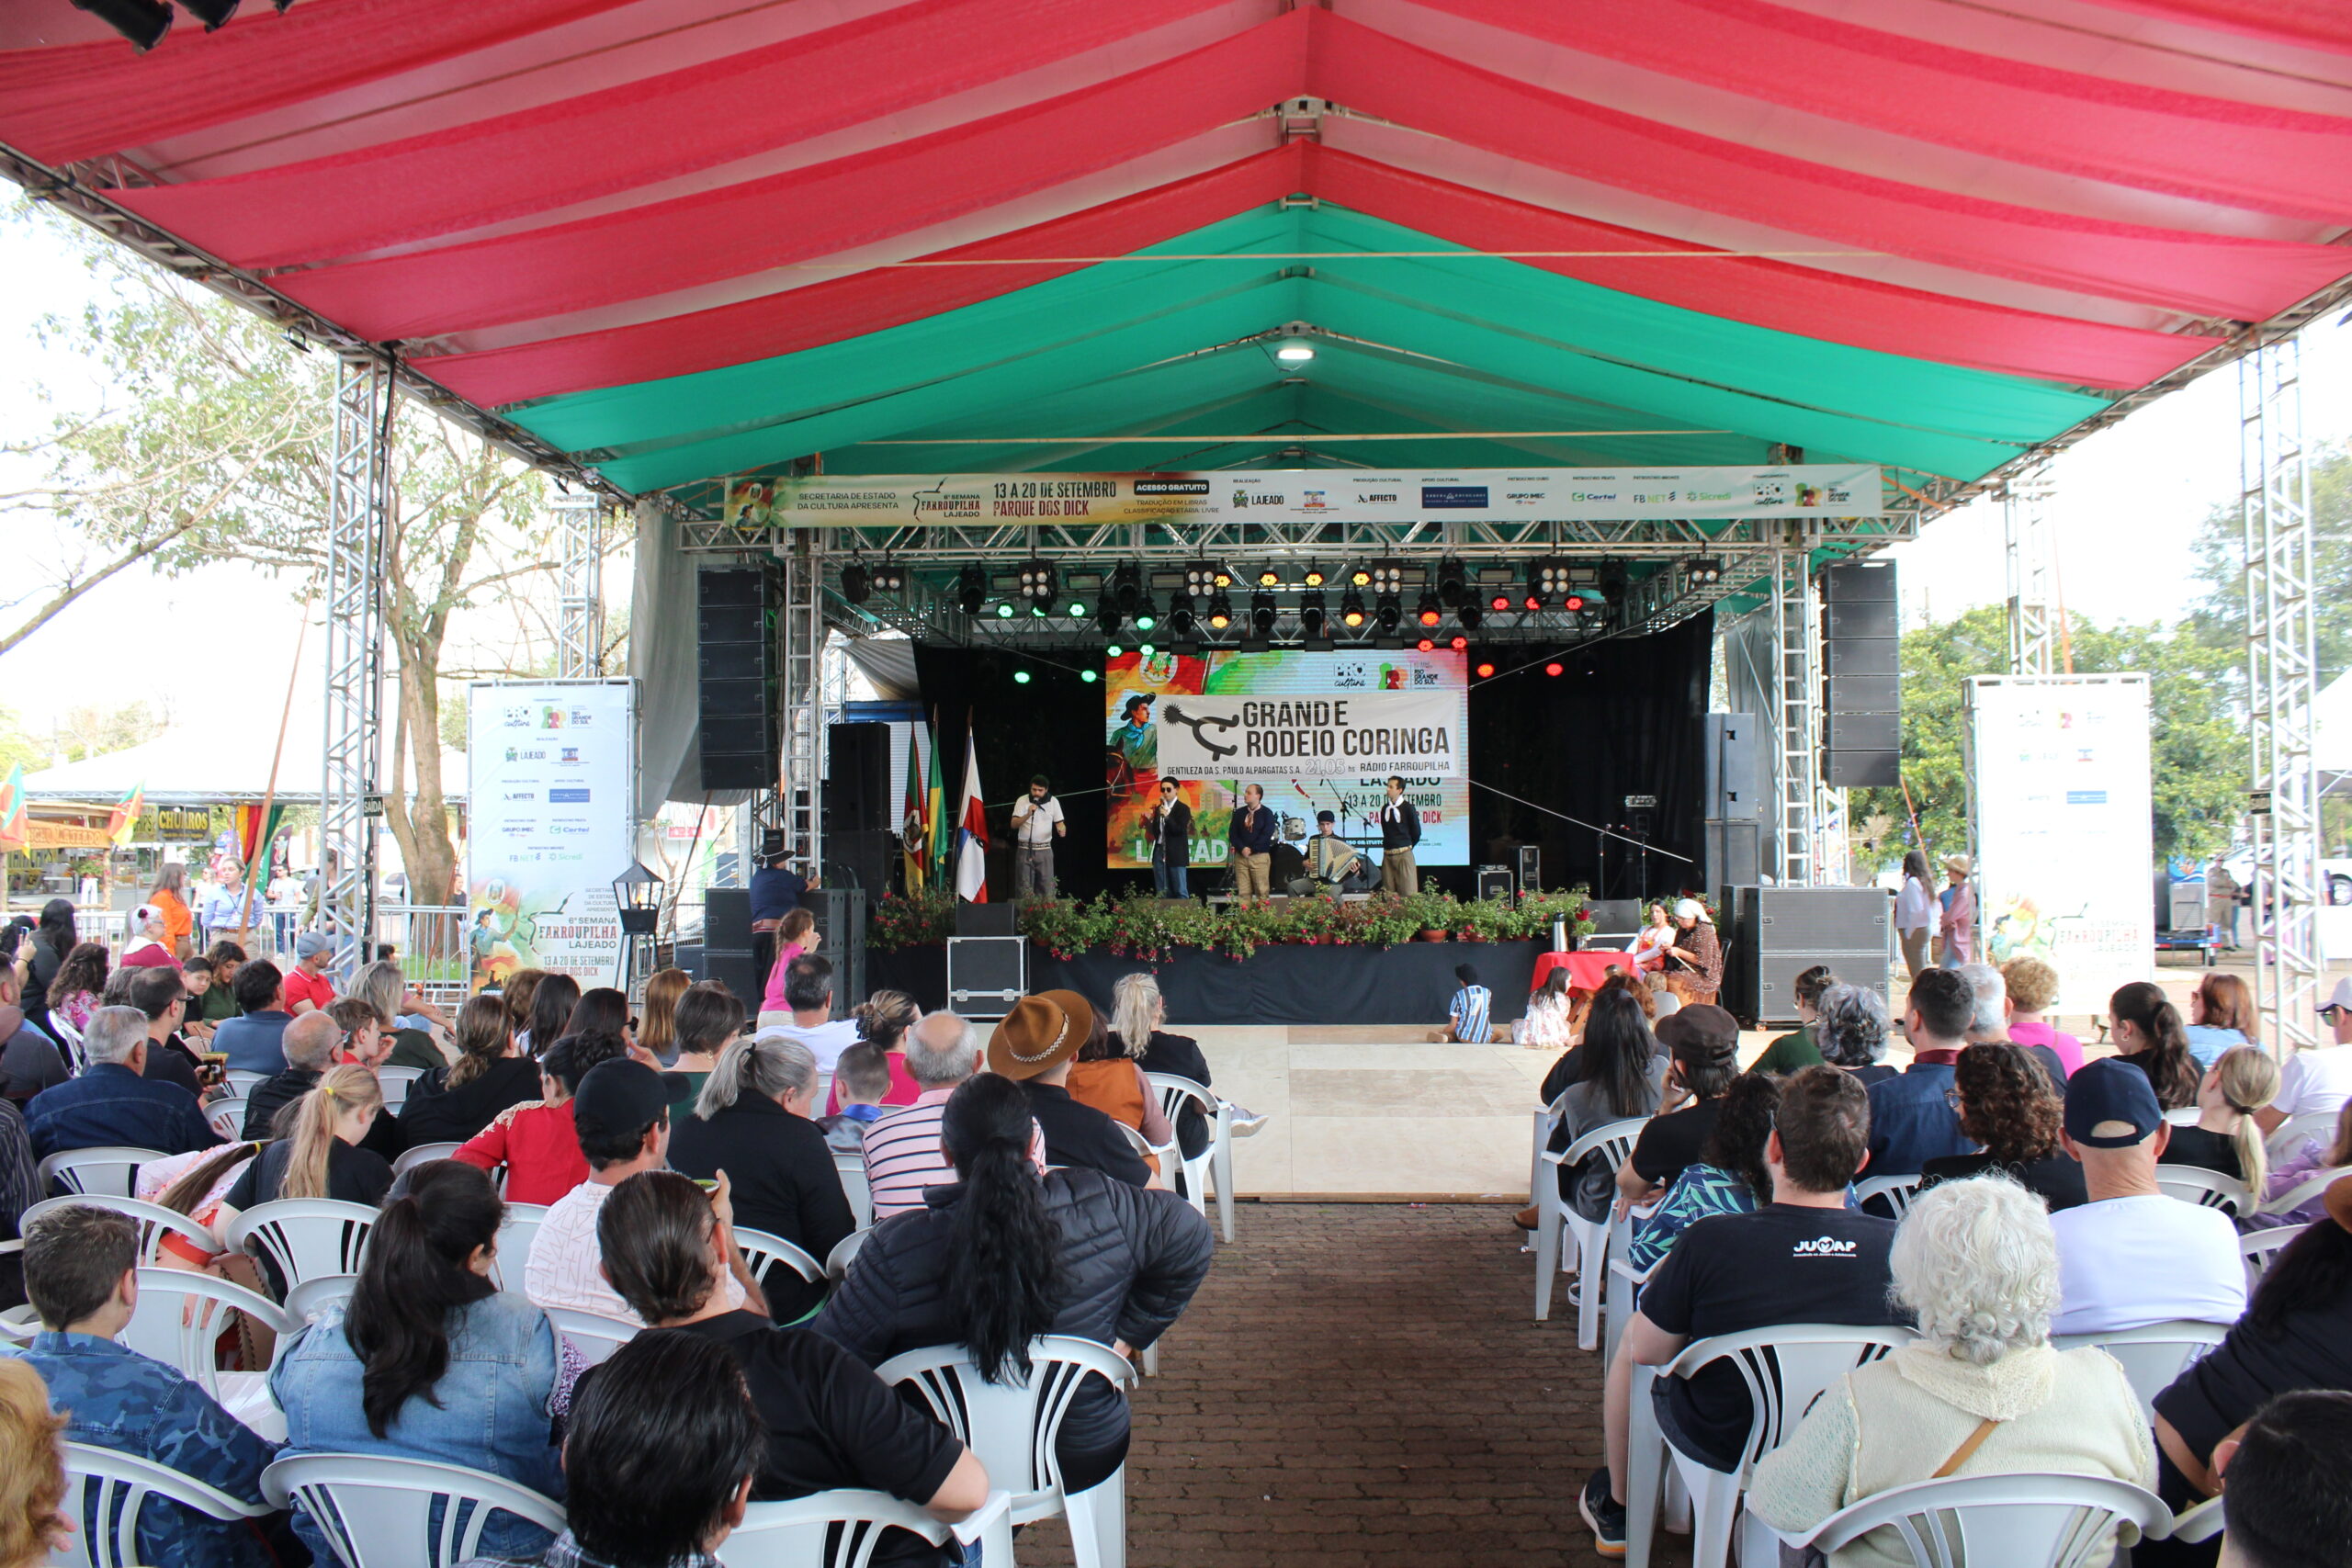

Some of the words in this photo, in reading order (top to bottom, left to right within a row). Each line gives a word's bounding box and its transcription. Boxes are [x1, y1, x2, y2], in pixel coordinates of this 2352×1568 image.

[993, 483, 1007, 499] 13
[1011, 482, 1017, 498] A
[1022, 482, 1036, 498] 20
[1040, 482, 1054, 497] DE
[1057, 481, 1116, 497] SETEMBRO
[1136, 483, 1168, 491] ACESSO
[1168, 483, 1207, 491] GRATUITO
[798, 492, 849, 501] SECRETARIA
[863, 491, 897, 500] ESTADO
[1251, 494, 1284, 505] LAJEADO
[1700, 491, 1731, 501] Sicredi
[852, 502, 899, 510] APRESENTA
[922, 501, 980, 511] FARROUPILHA
[993, 501, 1035, 517] PARQUE
[1039, 501, 1060, 515] DOS
[1064, 500, 1090, 515] DICK
[1334, 678, 1366, 689] cultura
[1243, 700, 1349, 728] GRANDE
[1247, 729, 1335, 757] RODEIO
[1343, 727, 1450, 756] CORINGA
[520, 750, 546, 760] LAJEADO
[1167, 766, 1204, 775] GENTILEZA
[1204, 766, 1215, 775] DA
[1215, 765, 1222, 775] S.
[1223, 765, 1244, 775] PAULO
[1245, 765, 1288, 775] ALPARGATAS
[1289, 765, 1302, 774] S.A.
[1305, 759, 1346, 776] 21,05
[1360, 761, 1387, 773] RÁDIO
[1389, 761, 1451, 772] FARROUPILHA
[364, 797, 383, 813] SAÍDA
[1348, 794, 1358, 807] 13
[1361, 794, 1367, 807] A
[1369, 794, 1381, 807] 20
[158, 810, 209, 830] CHURROS
[1422, 810, 1442, 823] DICK
[539, 926, 617, 939] FARROUPILHA
[569, 941, 617, 949] LAJEADO
[544, 956, 552, 965] 13
[553, 956, 559, 965] A
[560, 956, 569, 965] 20
[571, 956, 578, 965] DE
[580, 956, 615, 966] SETEMBRO
[570, 967, 582, 976] DOS
[583, 967, 599, 976] DICK
